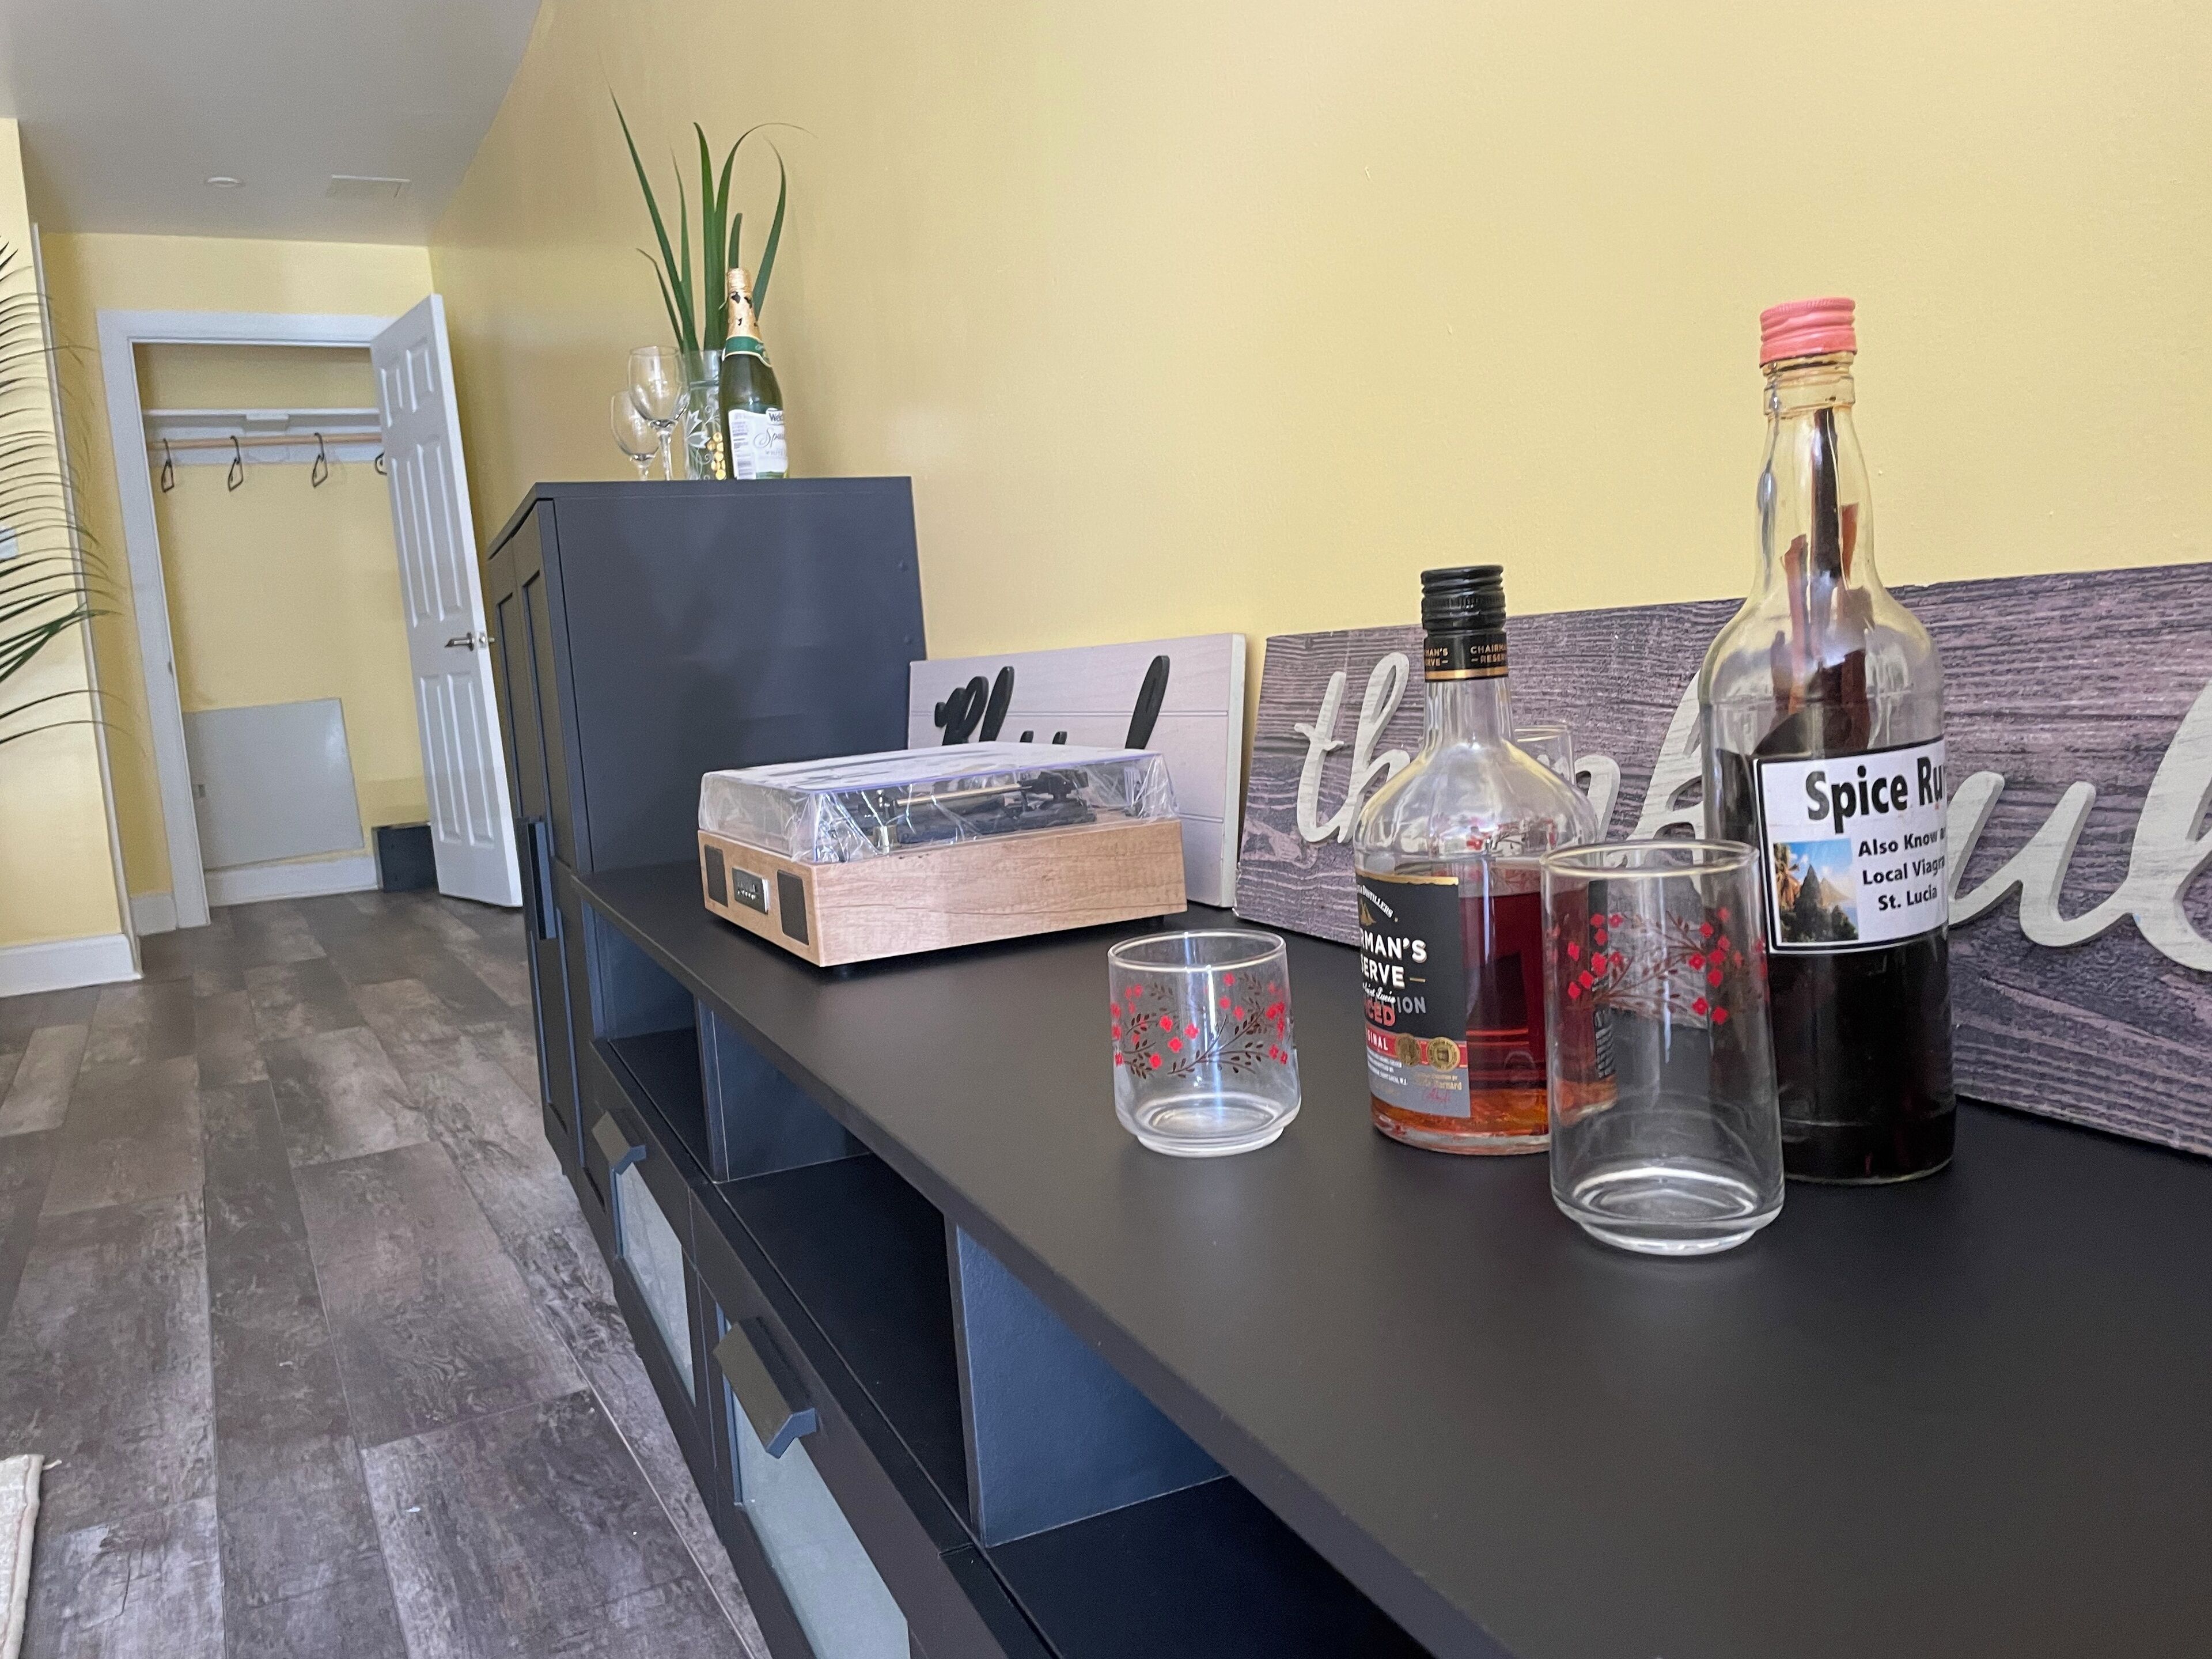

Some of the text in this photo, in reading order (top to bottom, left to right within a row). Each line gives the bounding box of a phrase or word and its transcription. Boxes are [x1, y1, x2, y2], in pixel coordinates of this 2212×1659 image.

[1805, 756, 1944, 834] Spice Ru
[1858, 837, 1899, 857] Also
[1903, 832, 1938, 851] Know
[1862, 863, 1908, 885] Local
[1878, 883, 1938, 911] St. Lucia
